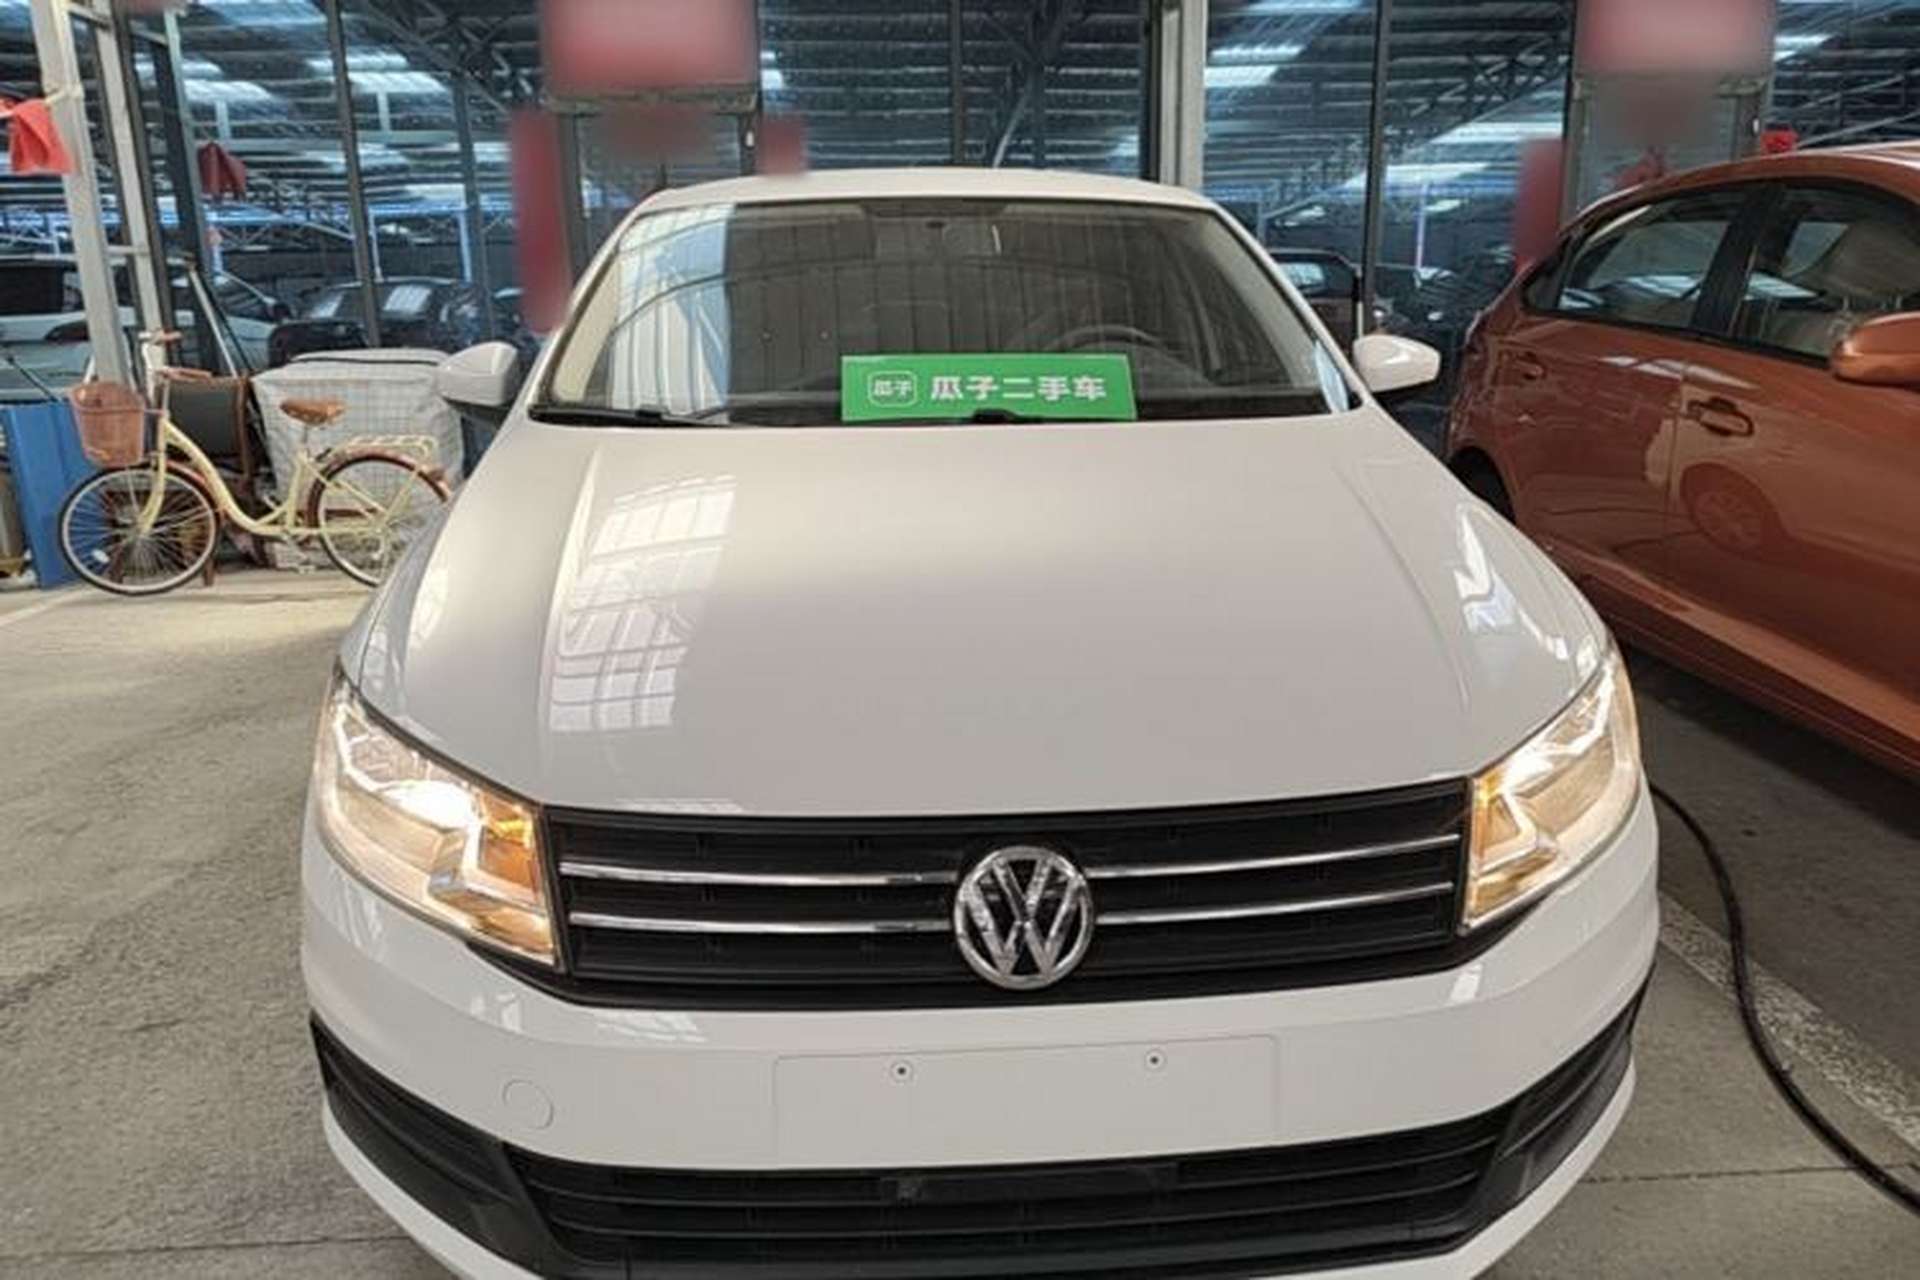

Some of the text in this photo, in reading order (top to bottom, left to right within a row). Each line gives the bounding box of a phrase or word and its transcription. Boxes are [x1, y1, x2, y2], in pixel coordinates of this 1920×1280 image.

[930, 375, 1107, 401] 瓜子二手车
